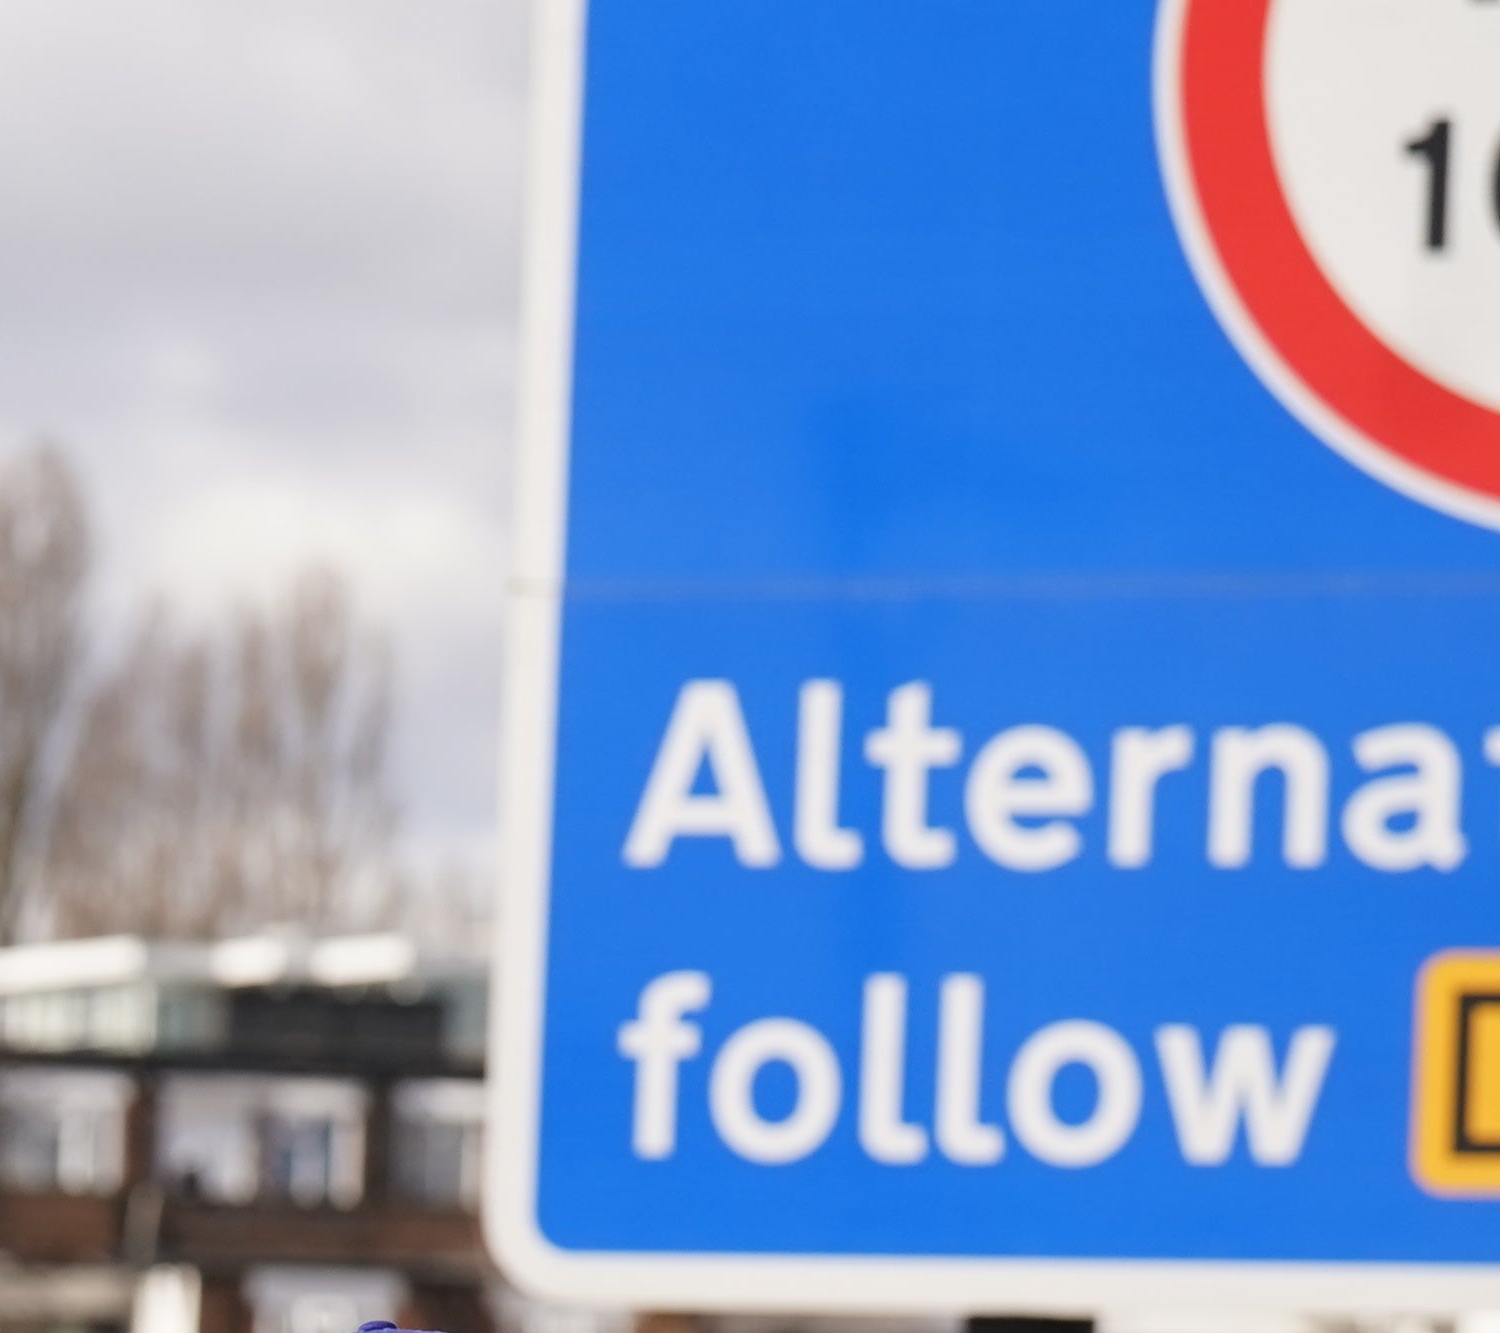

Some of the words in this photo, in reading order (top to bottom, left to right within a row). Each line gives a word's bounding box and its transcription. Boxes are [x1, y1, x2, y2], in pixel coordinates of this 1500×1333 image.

[1402, 113, 1500, 254] 1
[620, 678, 1500, 872] Alterna
[617, 970, 1337, 1168] follow
